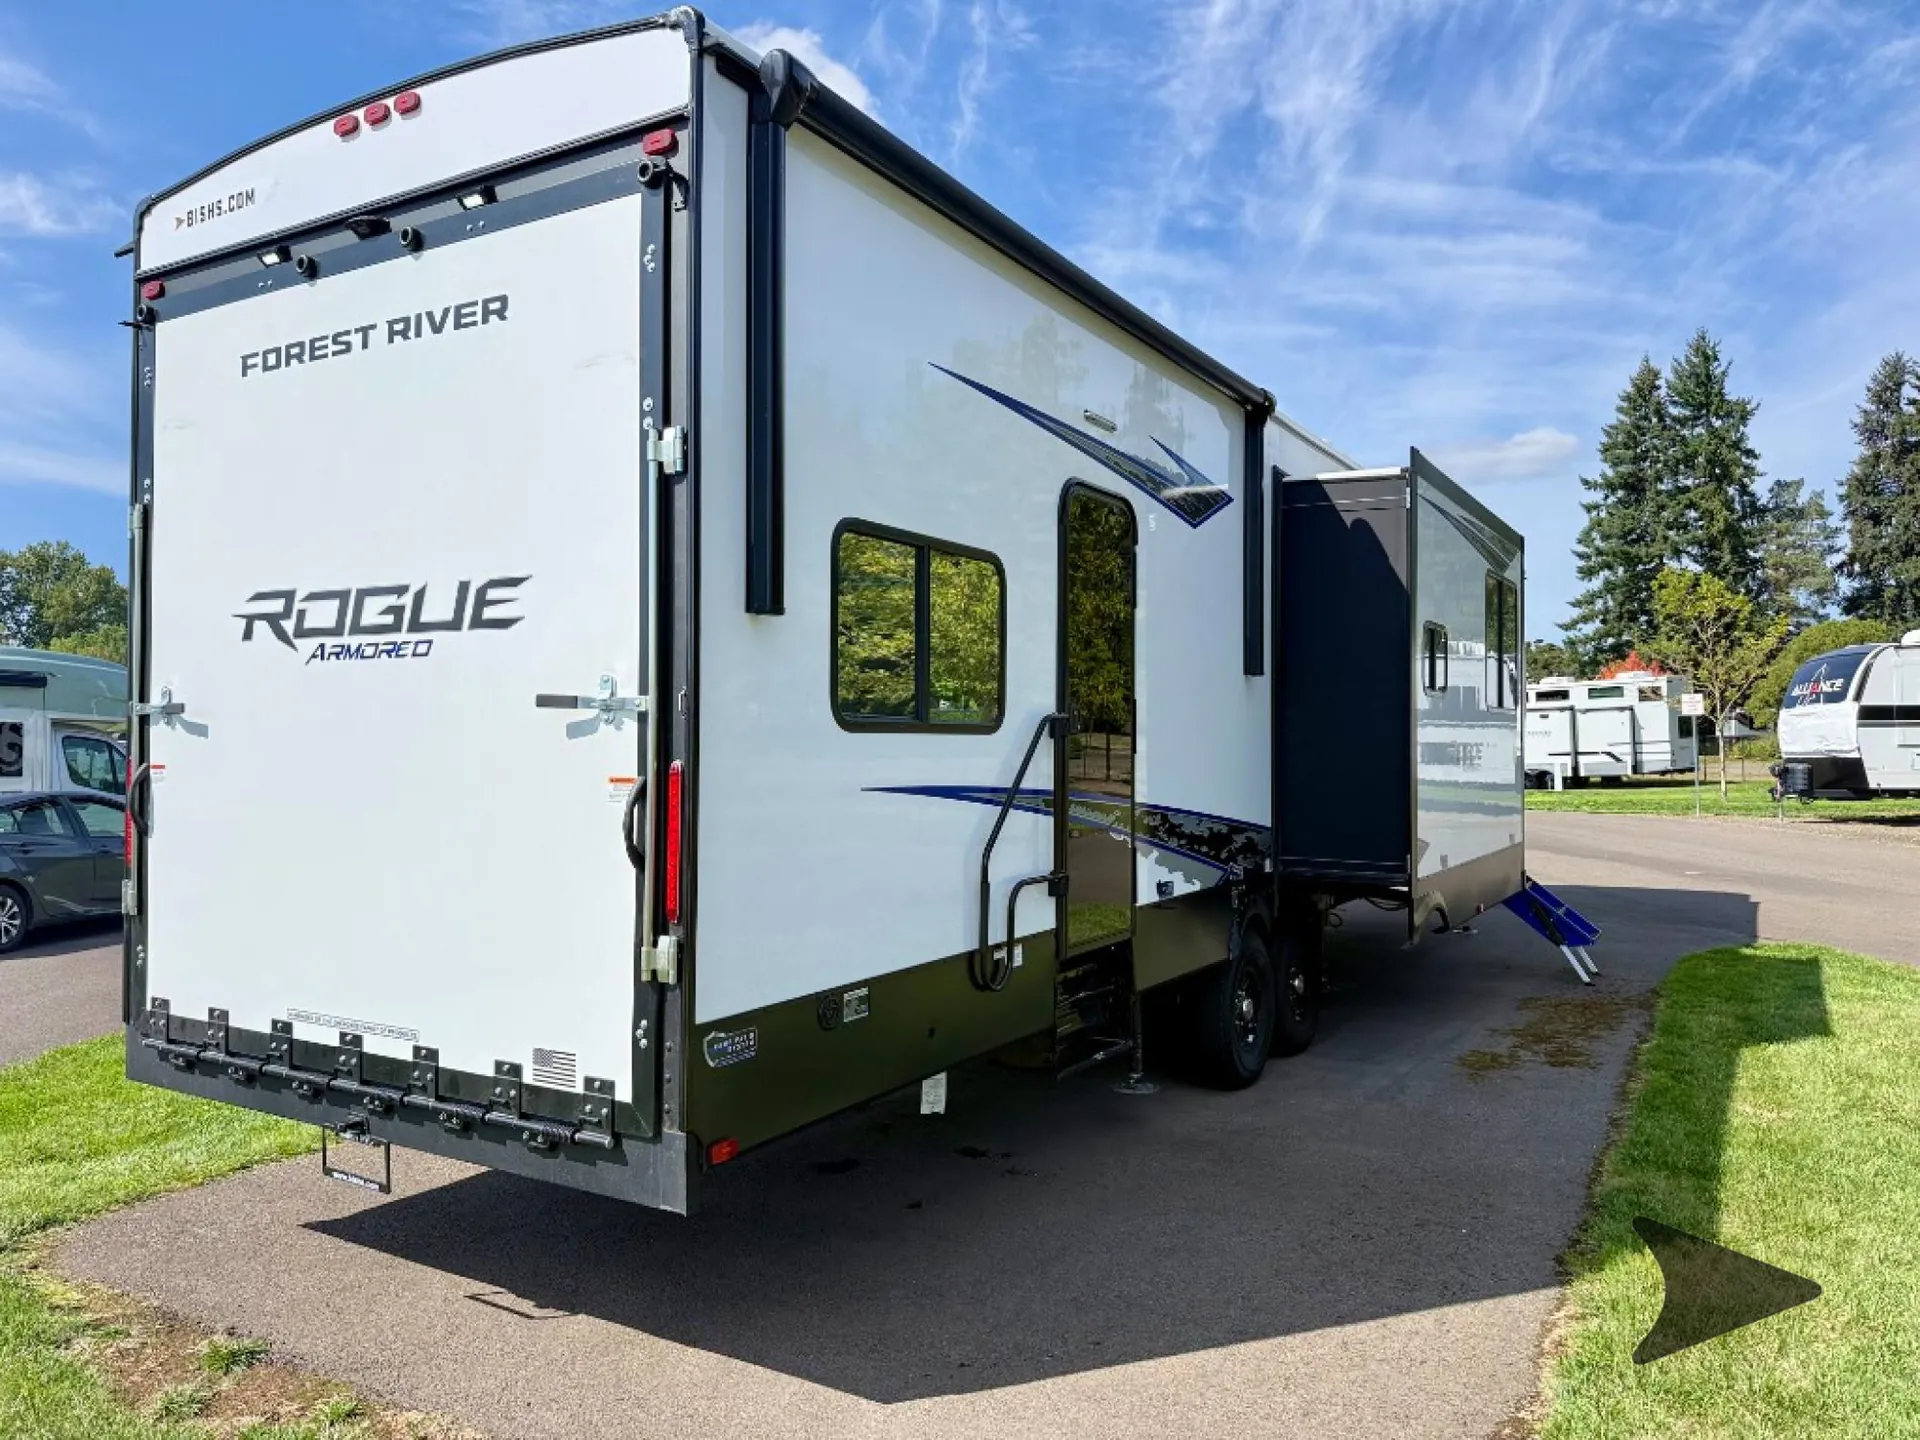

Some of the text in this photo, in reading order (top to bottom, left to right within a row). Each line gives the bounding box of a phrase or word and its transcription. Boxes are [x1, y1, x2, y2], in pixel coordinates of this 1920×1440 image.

[187, 188, 255, 227] BISHS.COM
[240, 294, 508, 377] FOREST RIVER
[231, 574, 533, 653] ROGUE
[305, 639, 433, 665] ARMORED
